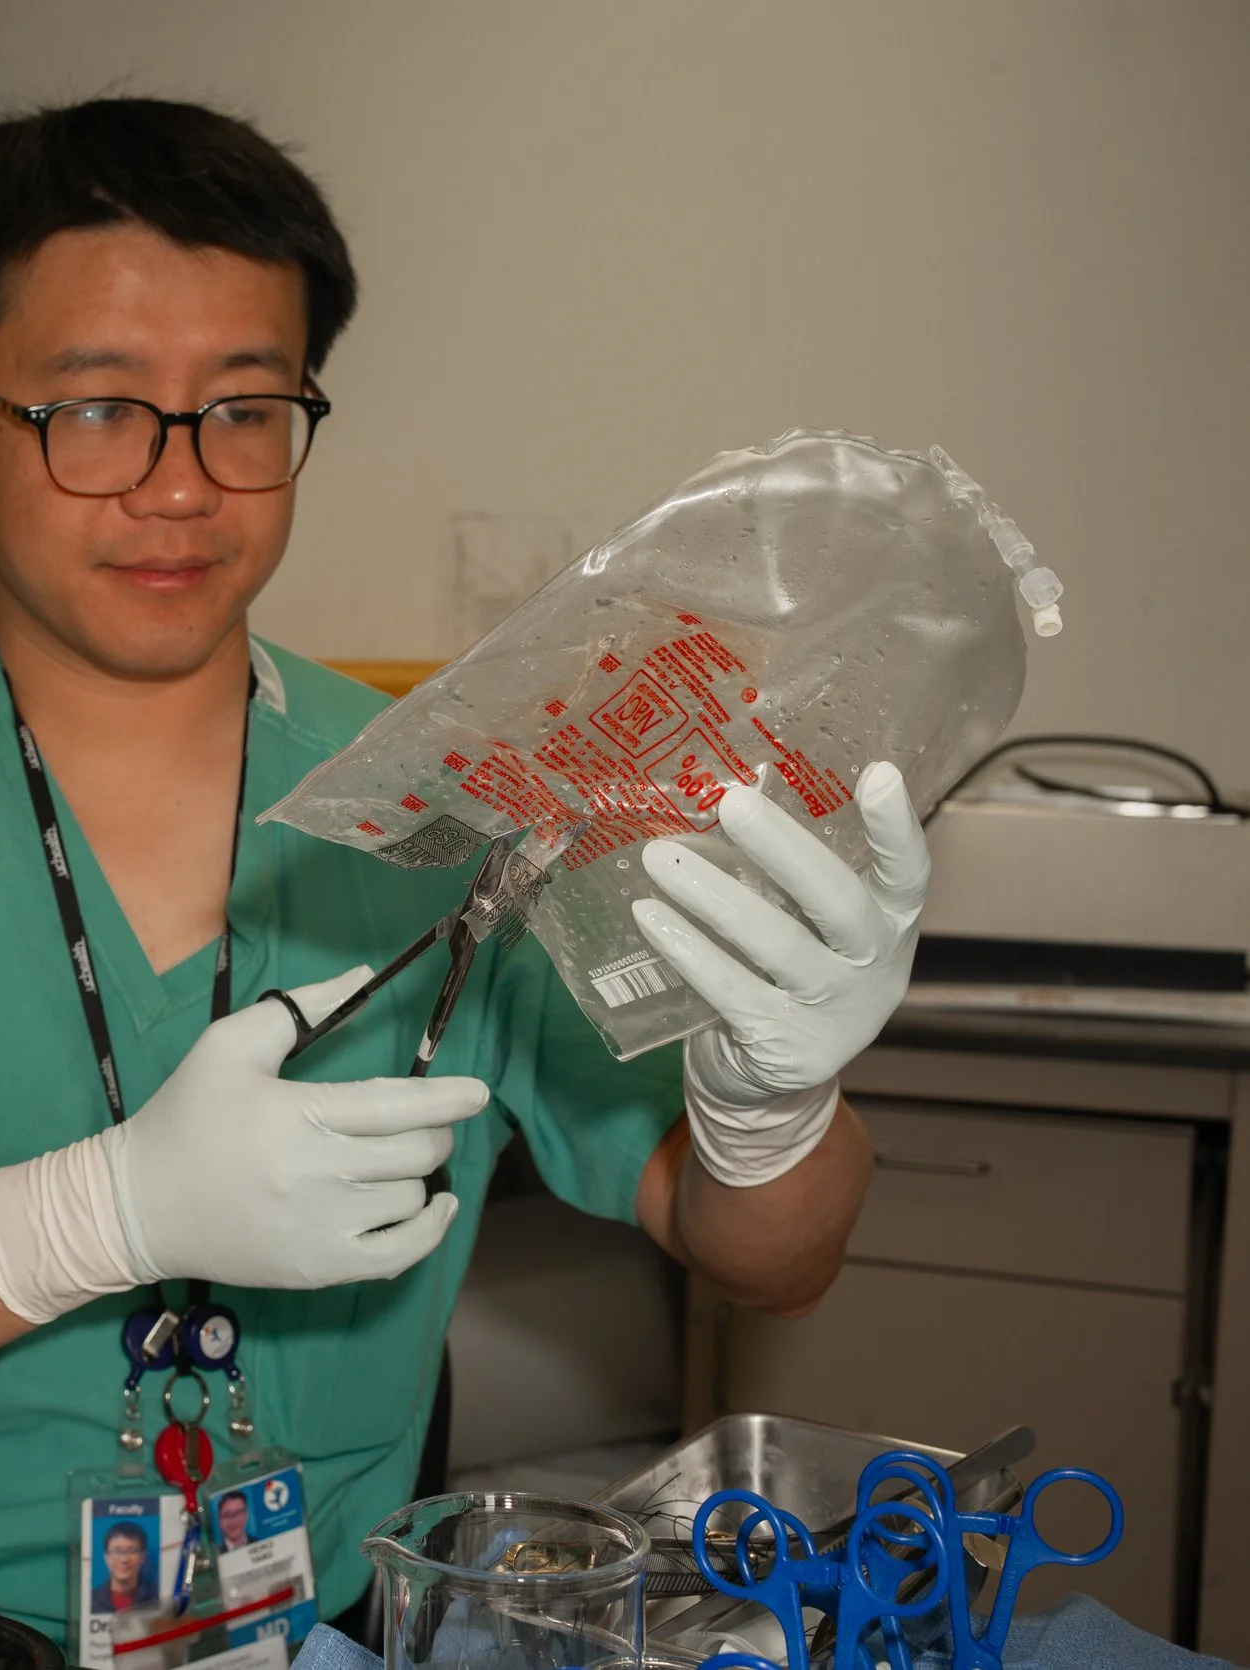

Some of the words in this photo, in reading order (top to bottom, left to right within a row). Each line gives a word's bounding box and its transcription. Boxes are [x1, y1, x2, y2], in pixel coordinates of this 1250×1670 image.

[597, 655, 618, 674] 600
[544, 702, 563, 717] 900
[645, 688, 675, 718] Irrigation
[599, 711, 625, 734] Chloride
[614, 692, 663, 735] NaCl
[619, 729, 641, 748] Sodium
[442, 753, 465, 772] 1500
[670, 752, 727, 814] 0.9%
[772, 758, 828, 817] Baxter
[400, 796, 423, 813] 1800
[356, 822, 380, 837] 2100
[423, 826, 469, 854] USP
[109, 1504, 144, 1516] Faculty
